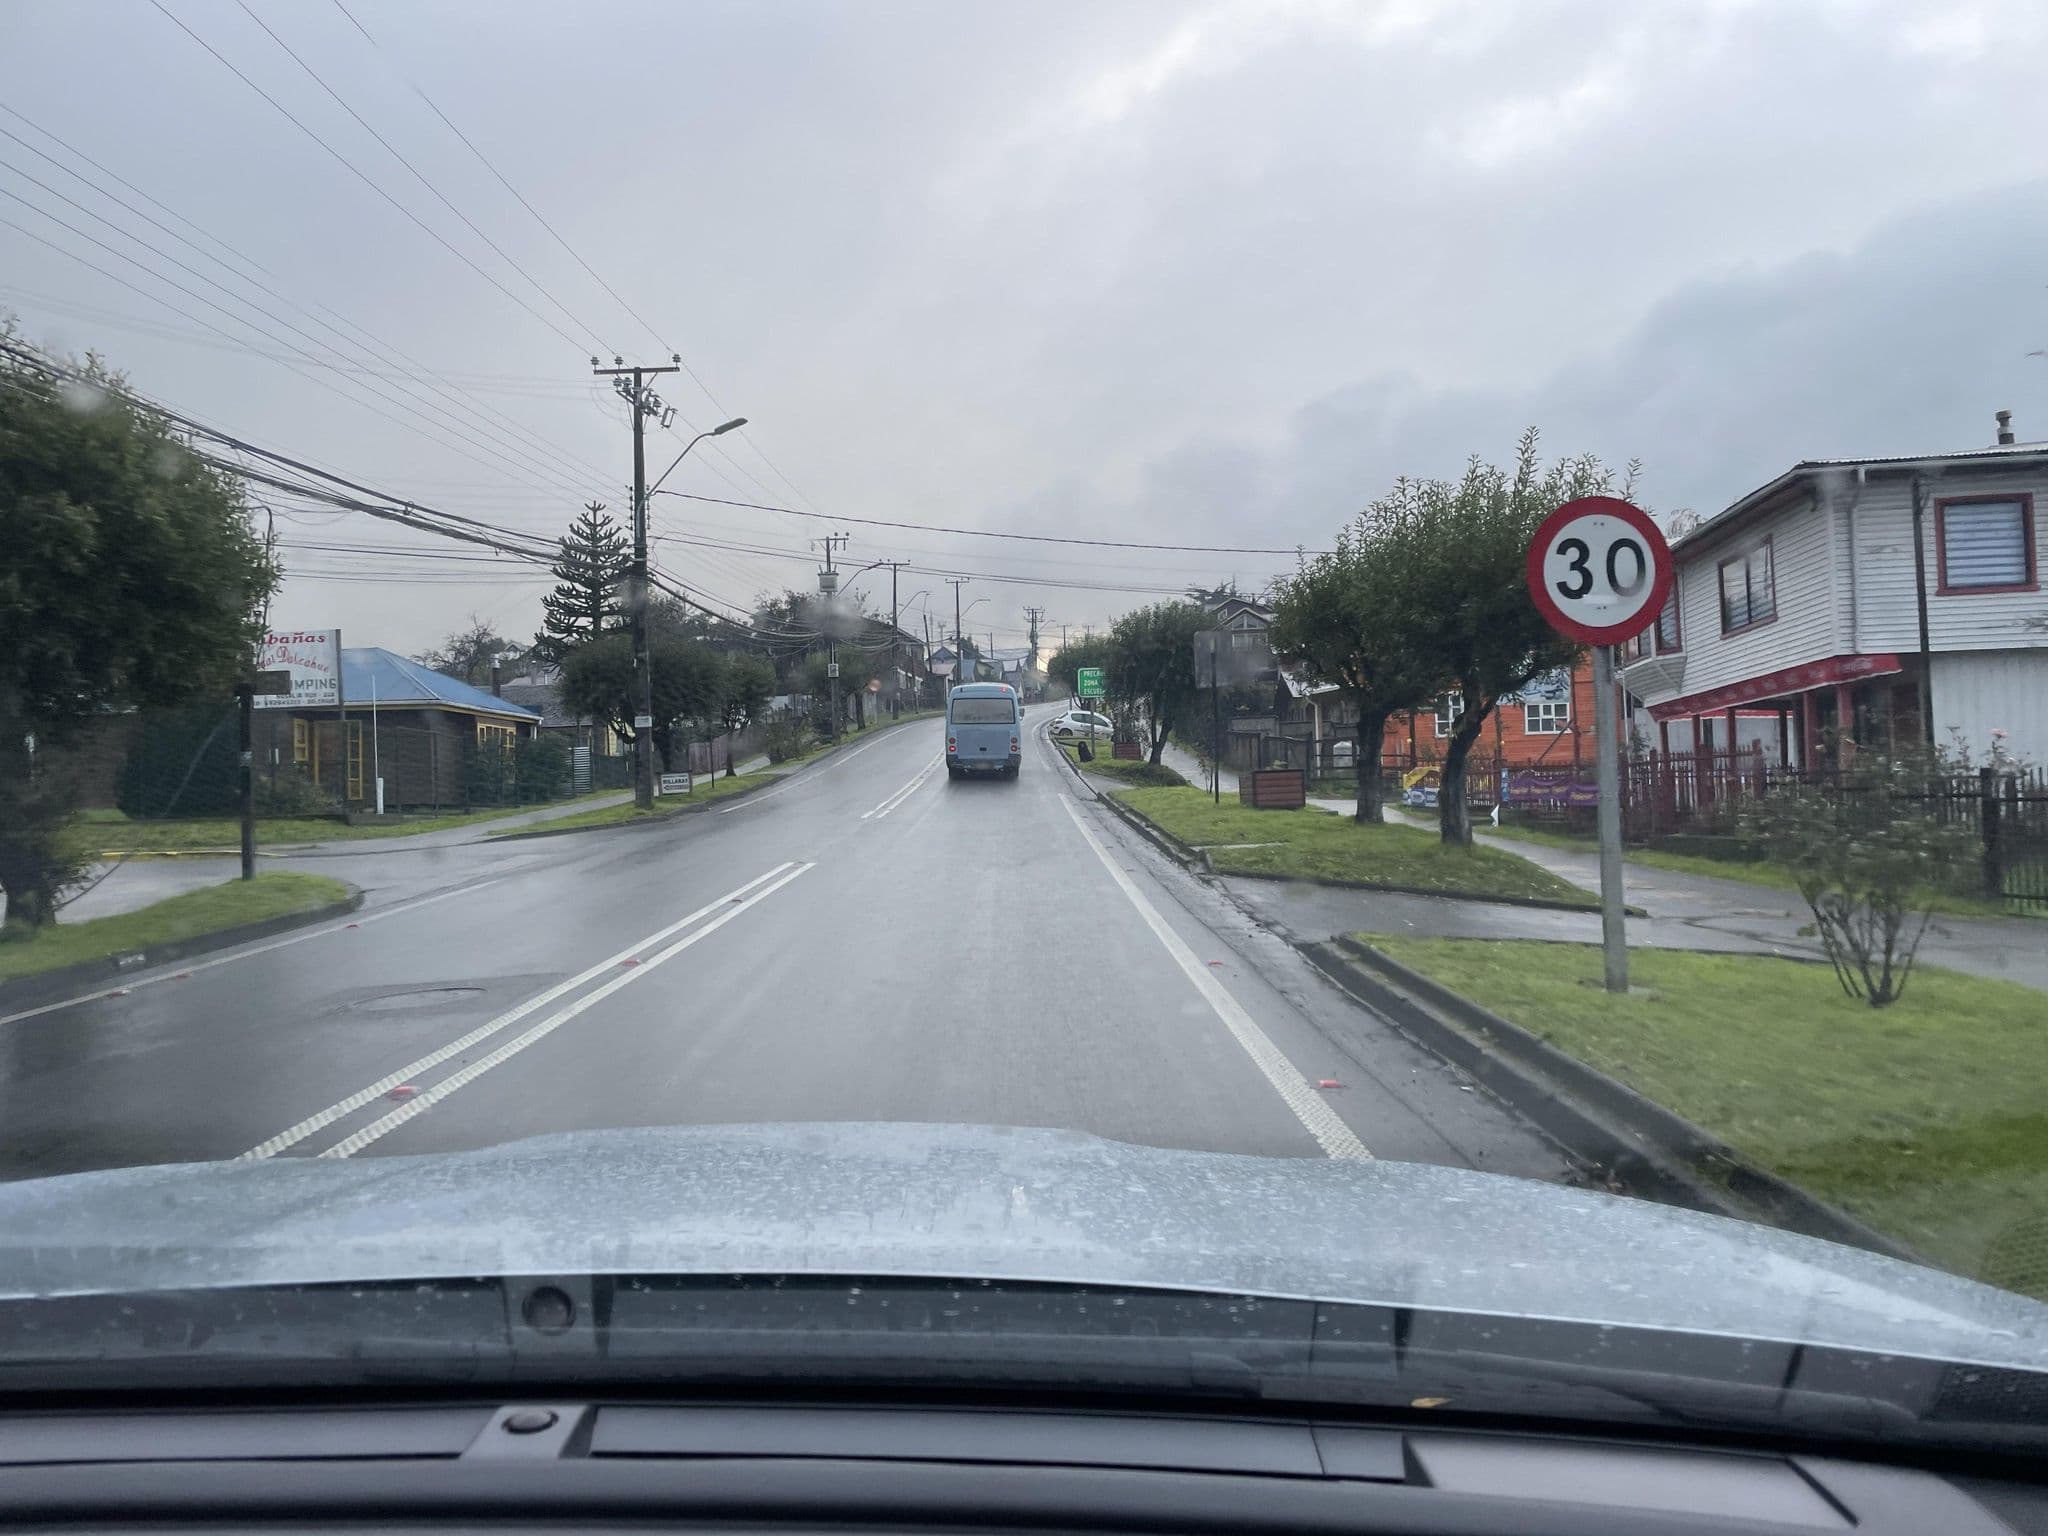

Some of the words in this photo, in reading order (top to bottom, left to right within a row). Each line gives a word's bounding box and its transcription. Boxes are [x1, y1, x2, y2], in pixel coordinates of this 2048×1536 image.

[1556, 538, 1646, 600] 30
[265, 632, 326, 645] bañas
[294, 678, 337, 691] MPING
